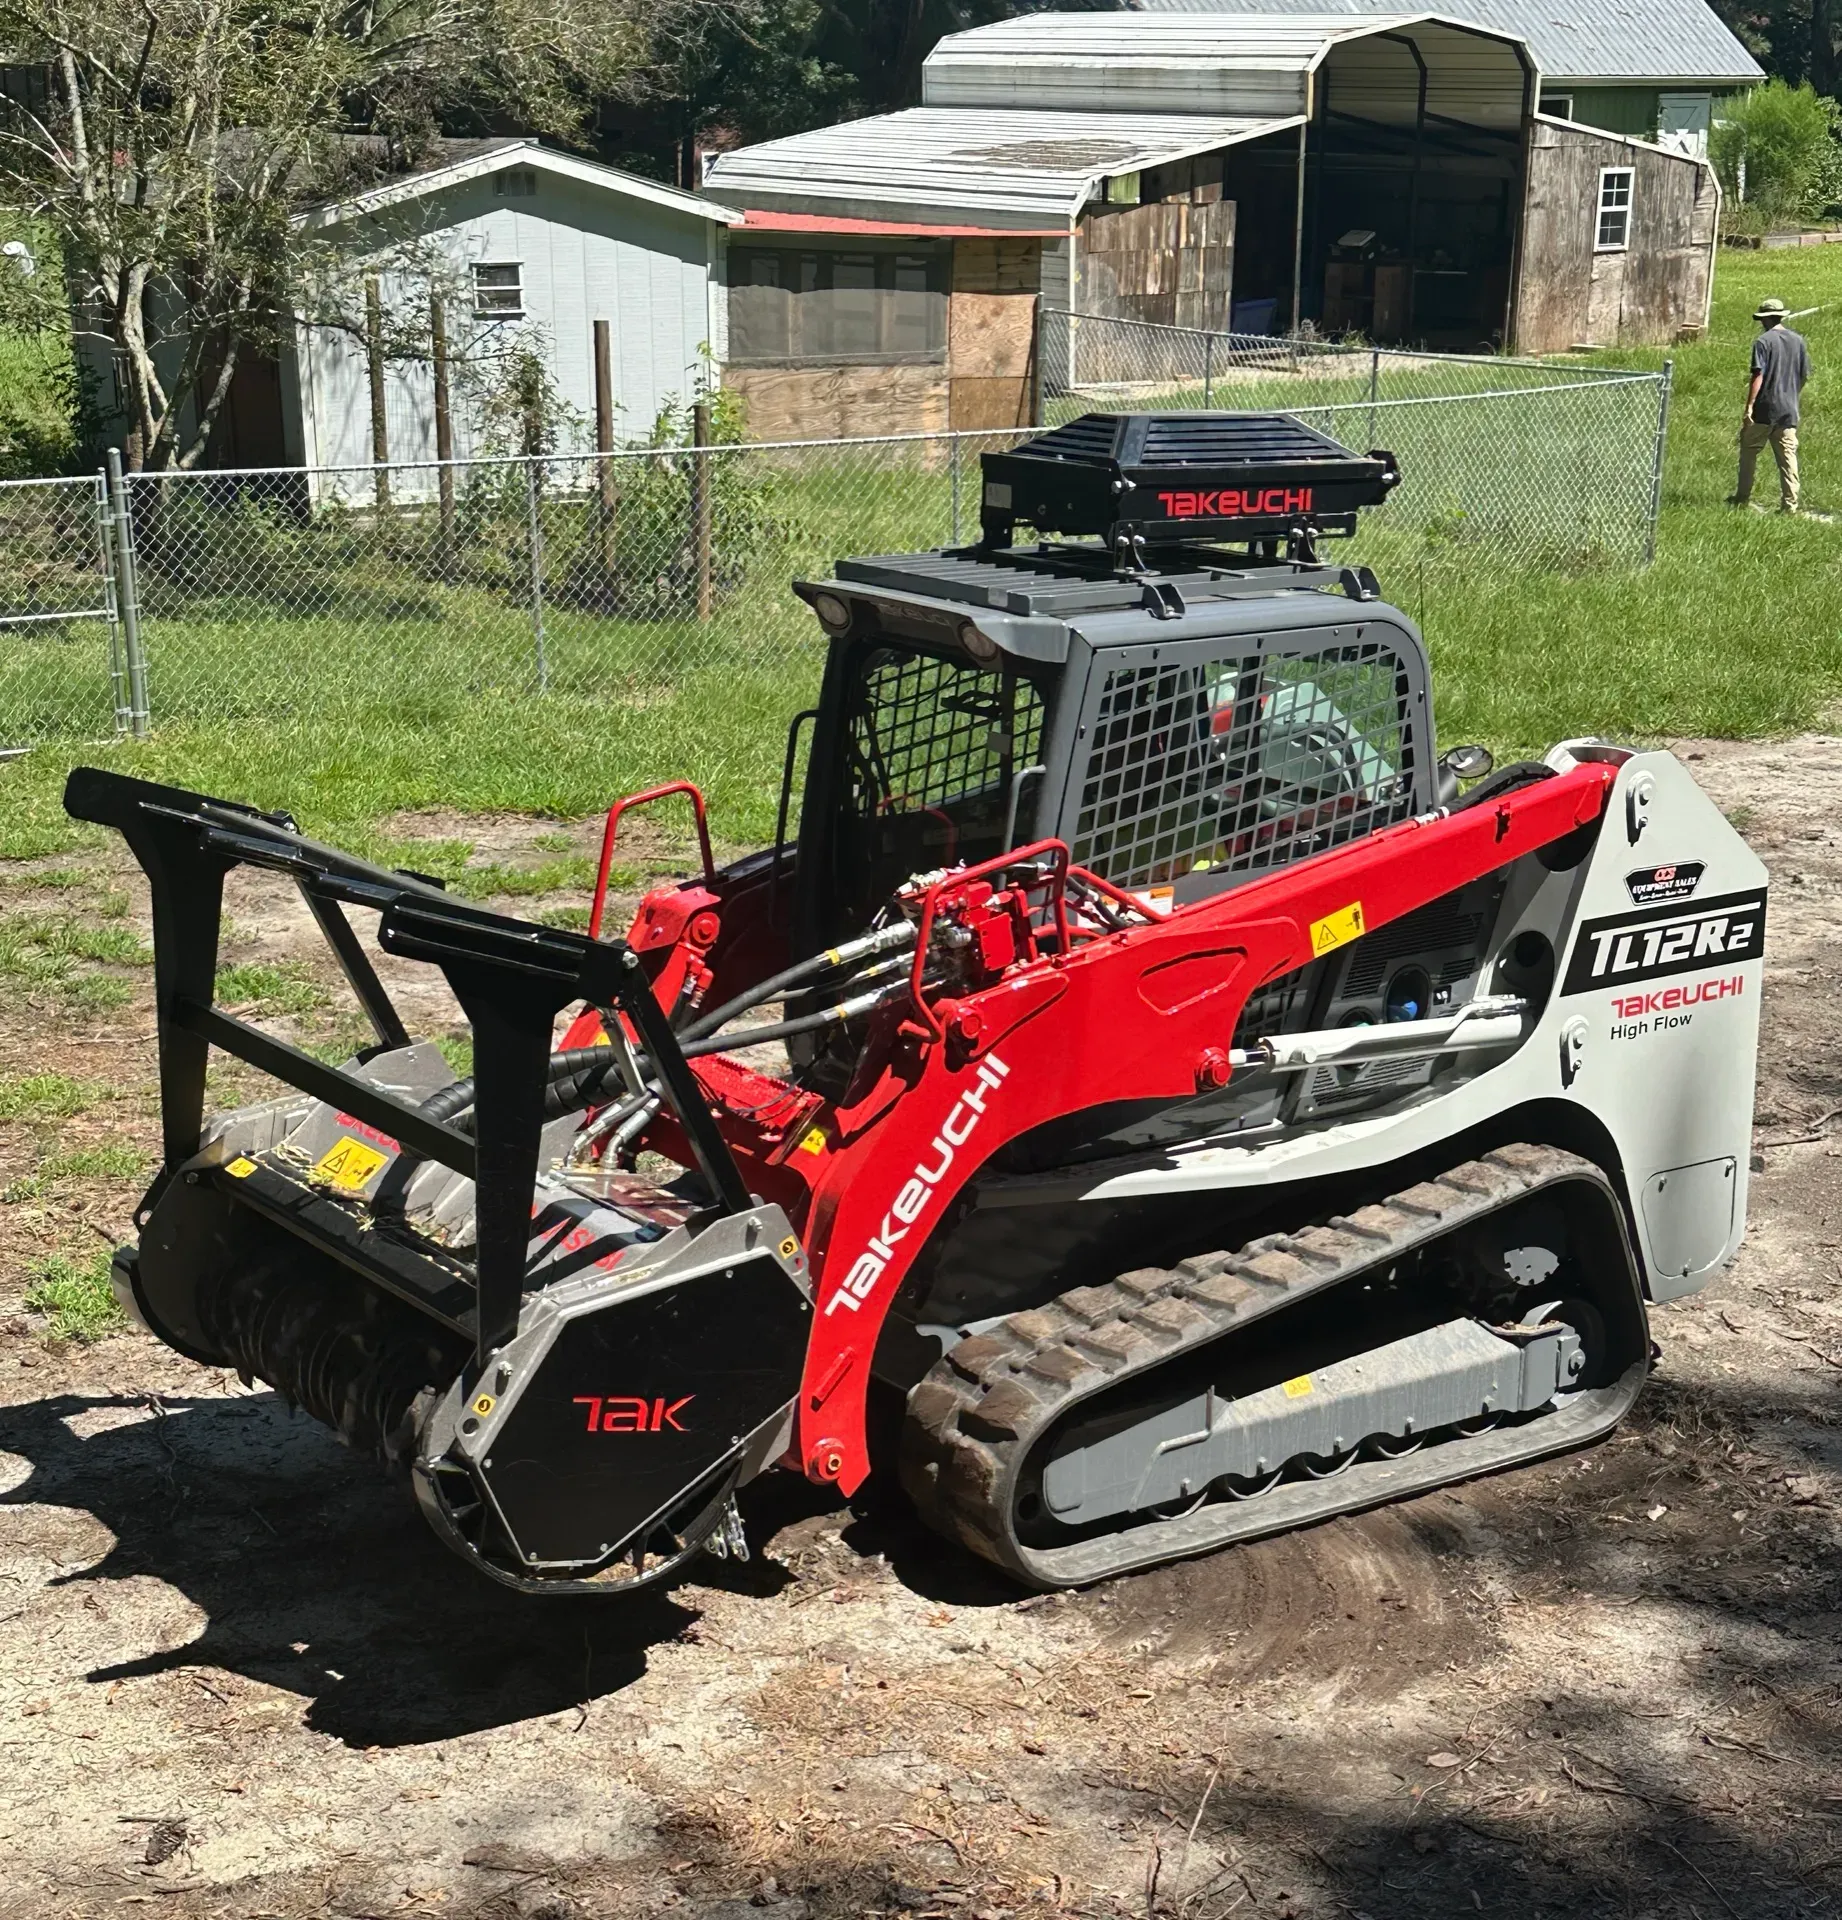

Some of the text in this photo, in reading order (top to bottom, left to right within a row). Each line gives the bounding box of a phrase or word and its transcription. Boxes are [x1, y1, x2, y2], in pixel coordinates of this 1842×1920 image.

[1158, 488, 1313, 517] TAKEUCHI
[1590, 901, 1761, 977] TL12R2
[1611, 975, 1744, 1019] TAKEUCHI
[1610, 1014, 1693, 1040] High Flow
[824, 1052, 1011, 1316] TAKEUCHI
[572, 1394, 697, 1432] TAK
